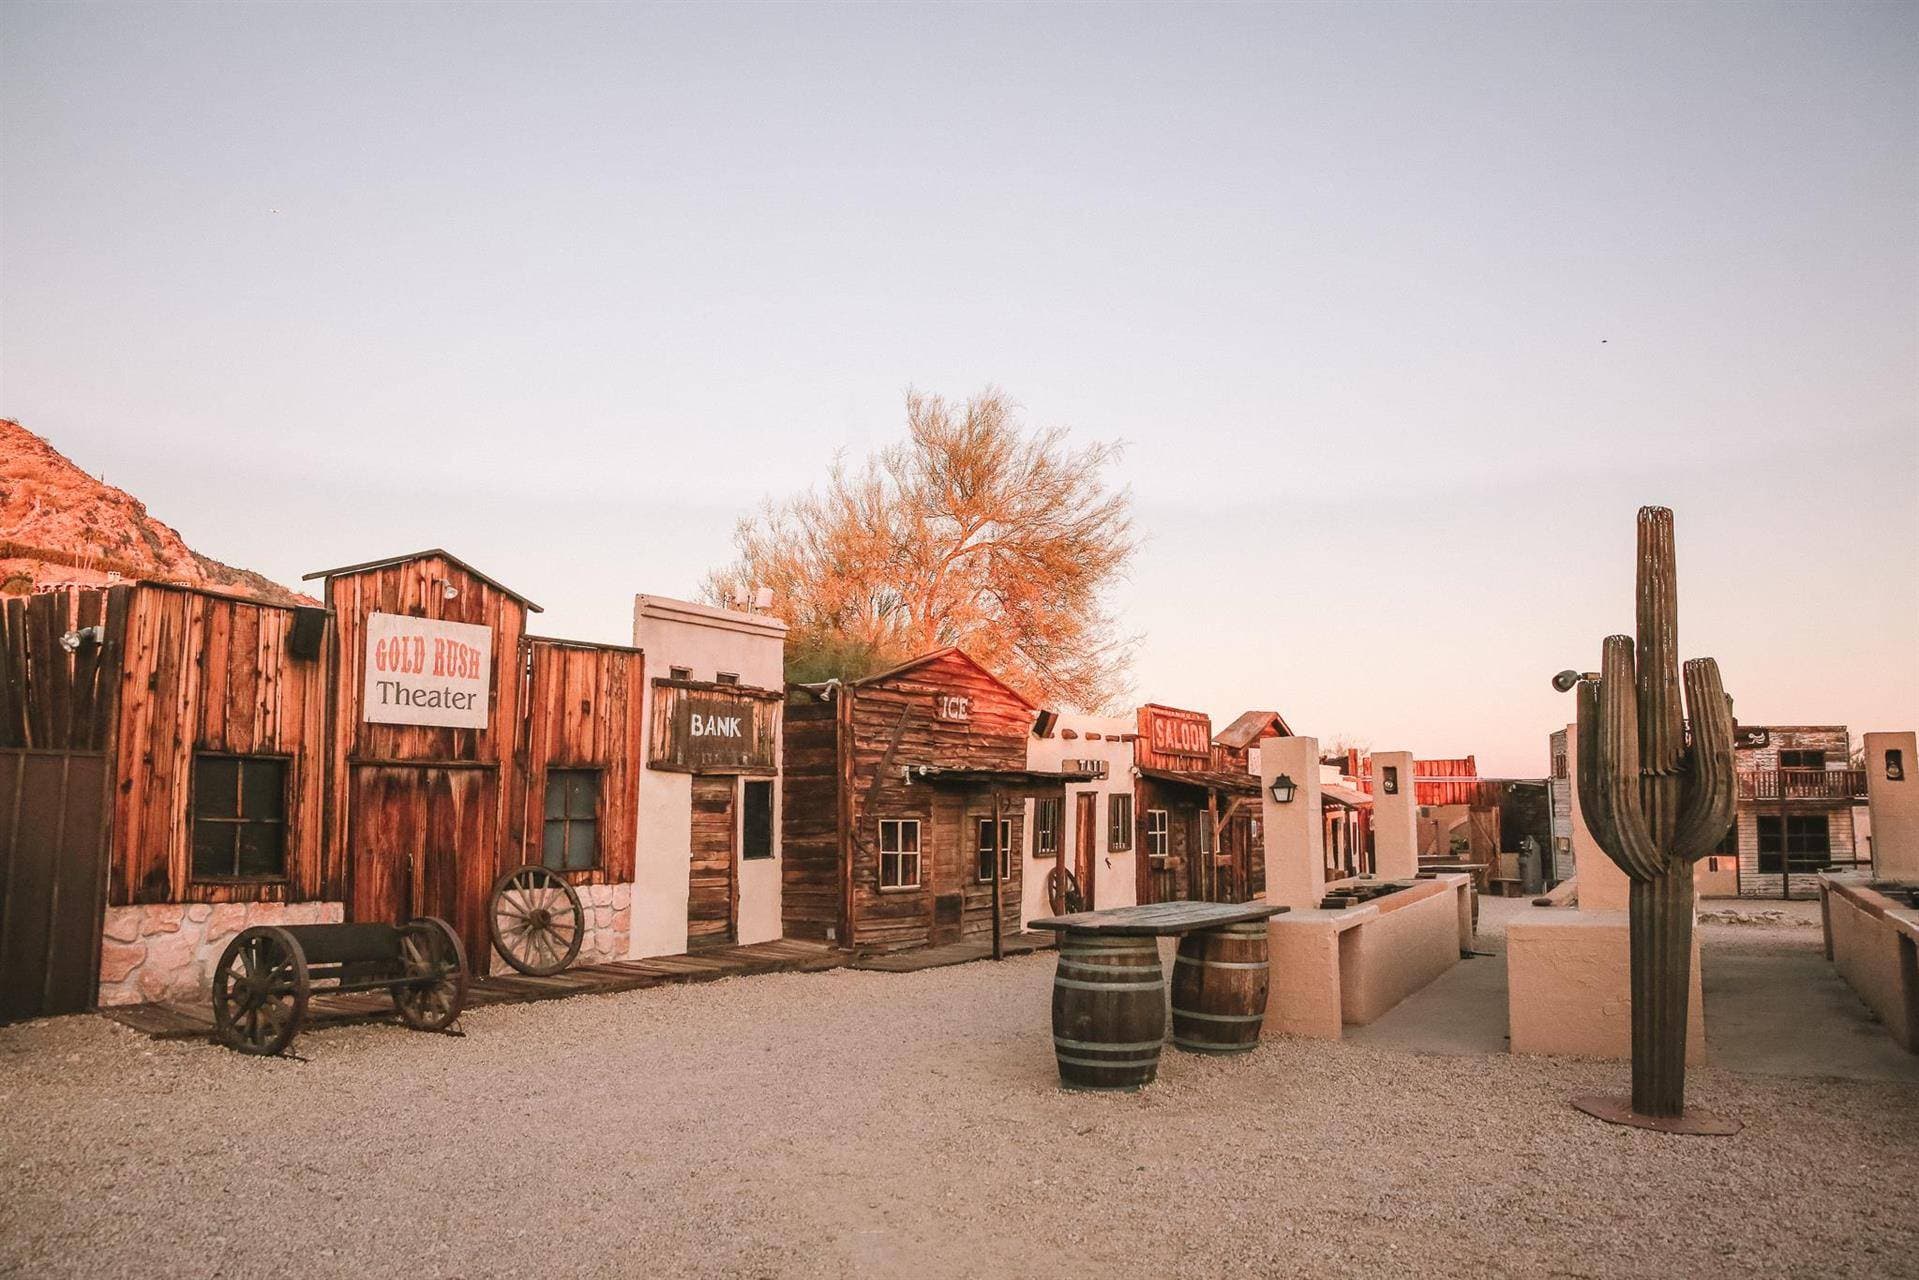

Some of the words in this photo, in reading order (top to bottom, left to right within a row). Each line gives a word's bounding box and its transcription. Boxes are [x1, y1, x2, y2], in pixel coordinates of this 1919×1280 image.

[376, 636, 425, 673] GOLD
[433, 638, 481, 679] RUSH
[376, 681, 477, 710] Theater
[942, 696, 968, 720] ICE
[691, 714, 742, 737] BANK
[1155, 718, 1208, 752] SALOON
